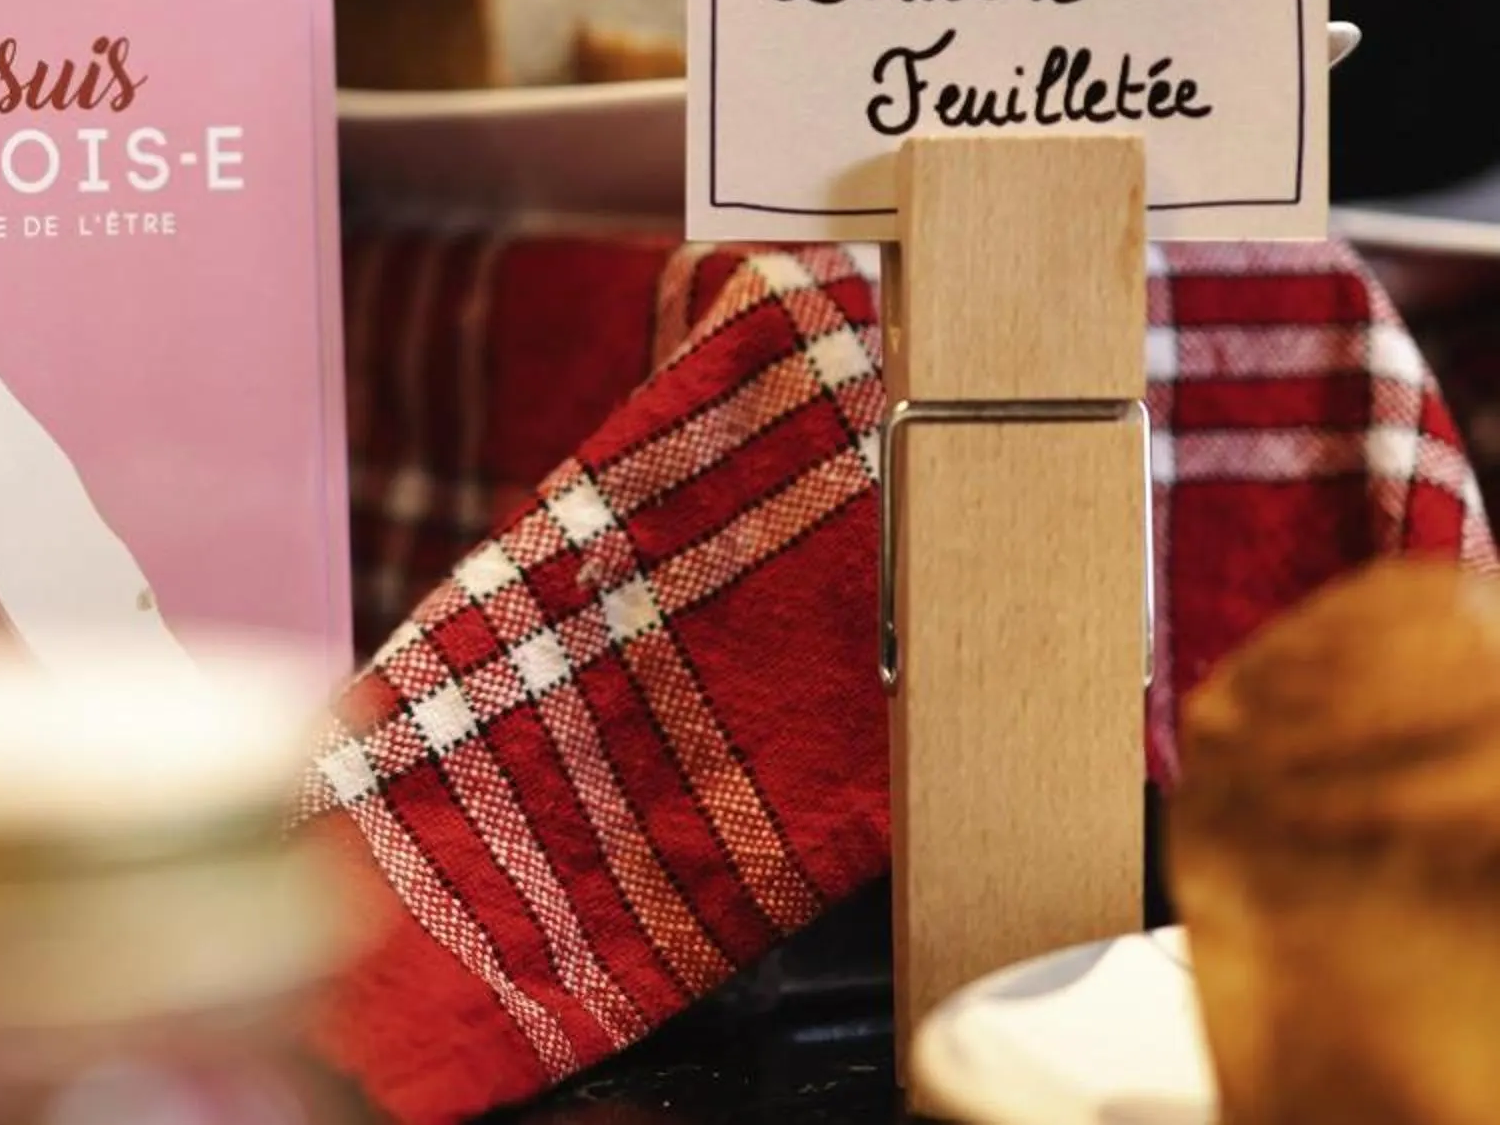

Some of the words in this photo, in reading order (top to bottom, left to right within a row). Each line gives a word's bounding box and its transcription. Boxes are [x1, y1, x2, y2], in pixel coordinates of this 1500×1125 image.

[867, 29, 1212, 135] Feuilletée
[23, 213, 59, 238] DE
[78, 209, 178, 236] L'ÊTRE
